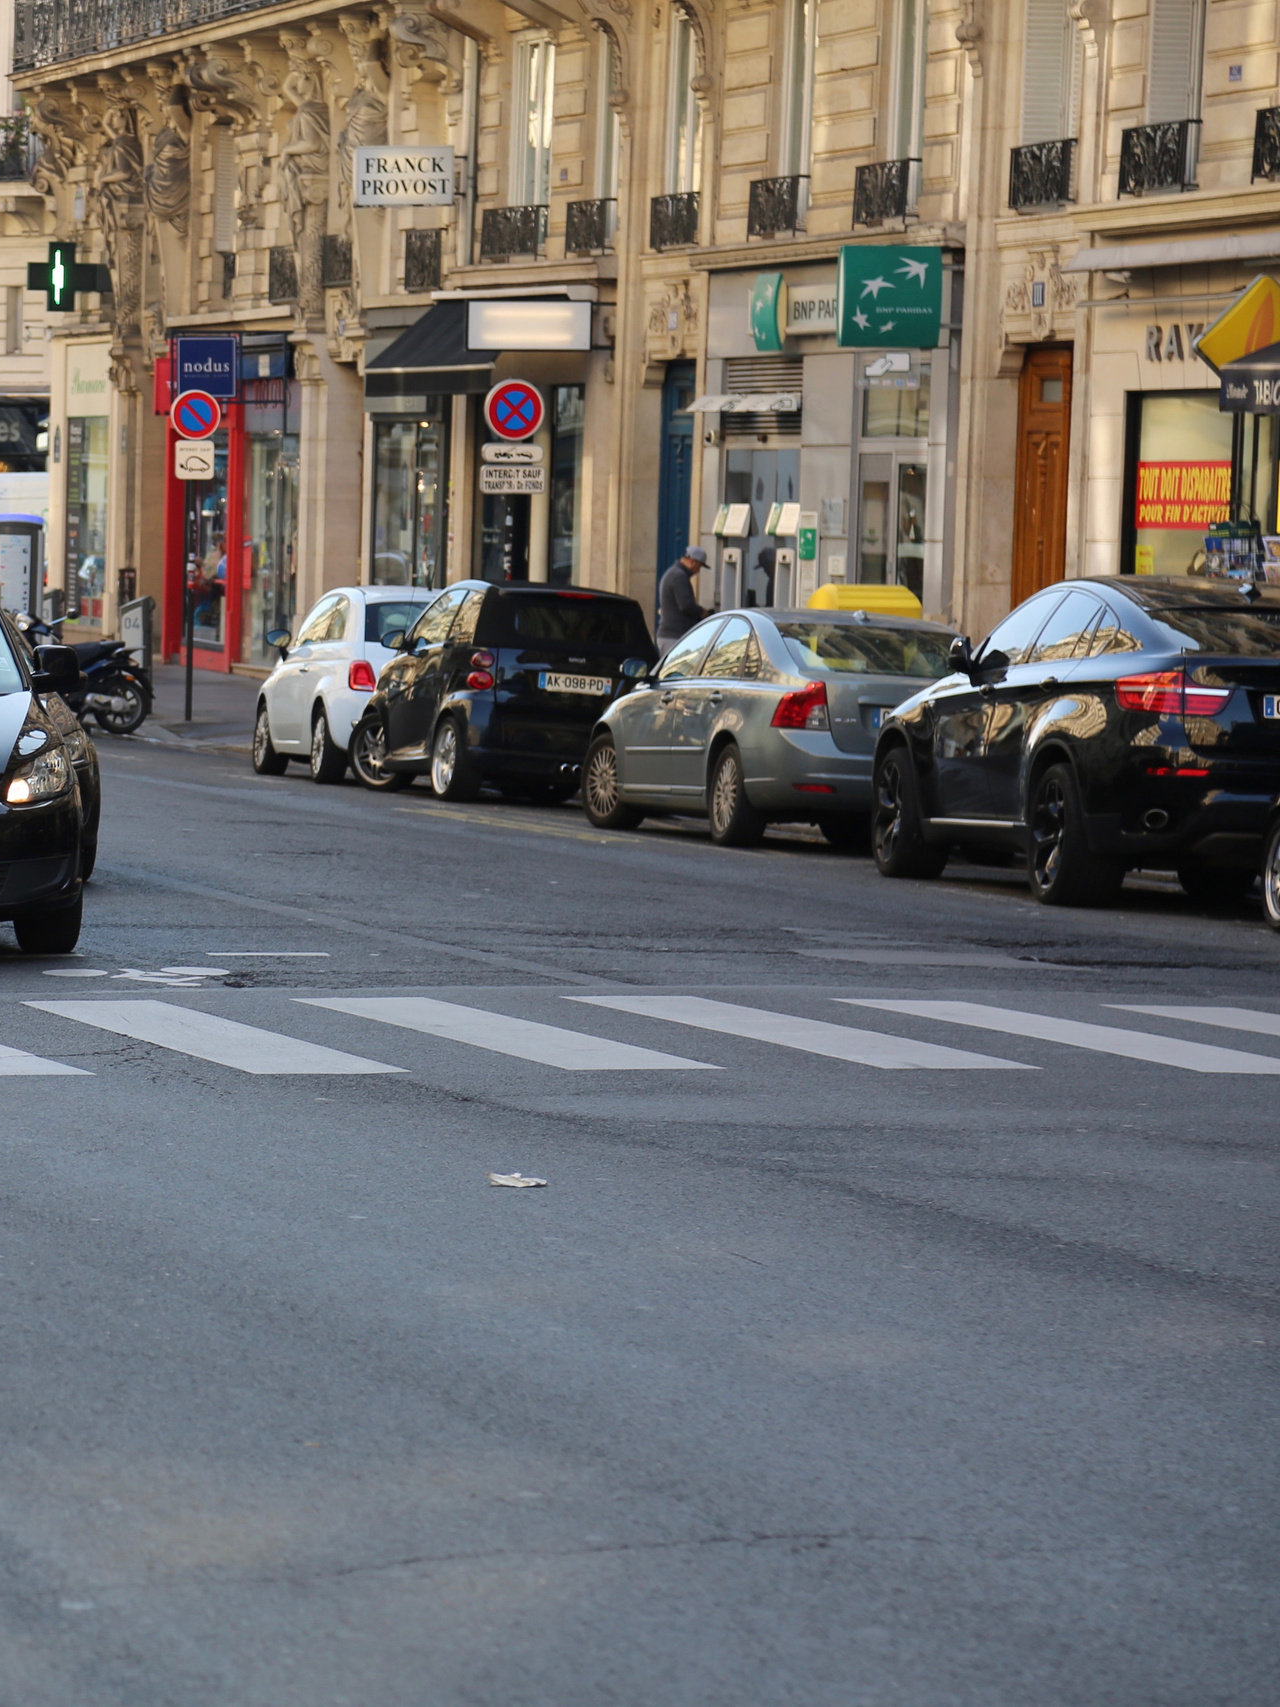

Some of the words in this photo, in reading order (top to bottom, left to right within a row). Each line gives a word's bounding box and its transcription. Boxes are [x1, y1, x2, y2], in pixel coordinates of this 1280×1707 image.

[365, 156, 445, 173] FRANCK
[362, 178, 451, 195] PROVOST
[793, 300, 816, 320] BNP
[876, 306, 894, 314] BNP
[896, 306, 933, 314] PARIBAS
[183, 357, 230, 373] nodus
[522, 469, 542, 479] SAUF
[524, 481, 543, 490] FONDS
[1139, 467, 1160, 501] TOUT
[1160, 467, 1180, 501] DOIT
[1139, 504, 1163, 523] POUR
[1165, 504, 1181, 523] FIN
[124, 617, 140, 630] 04
